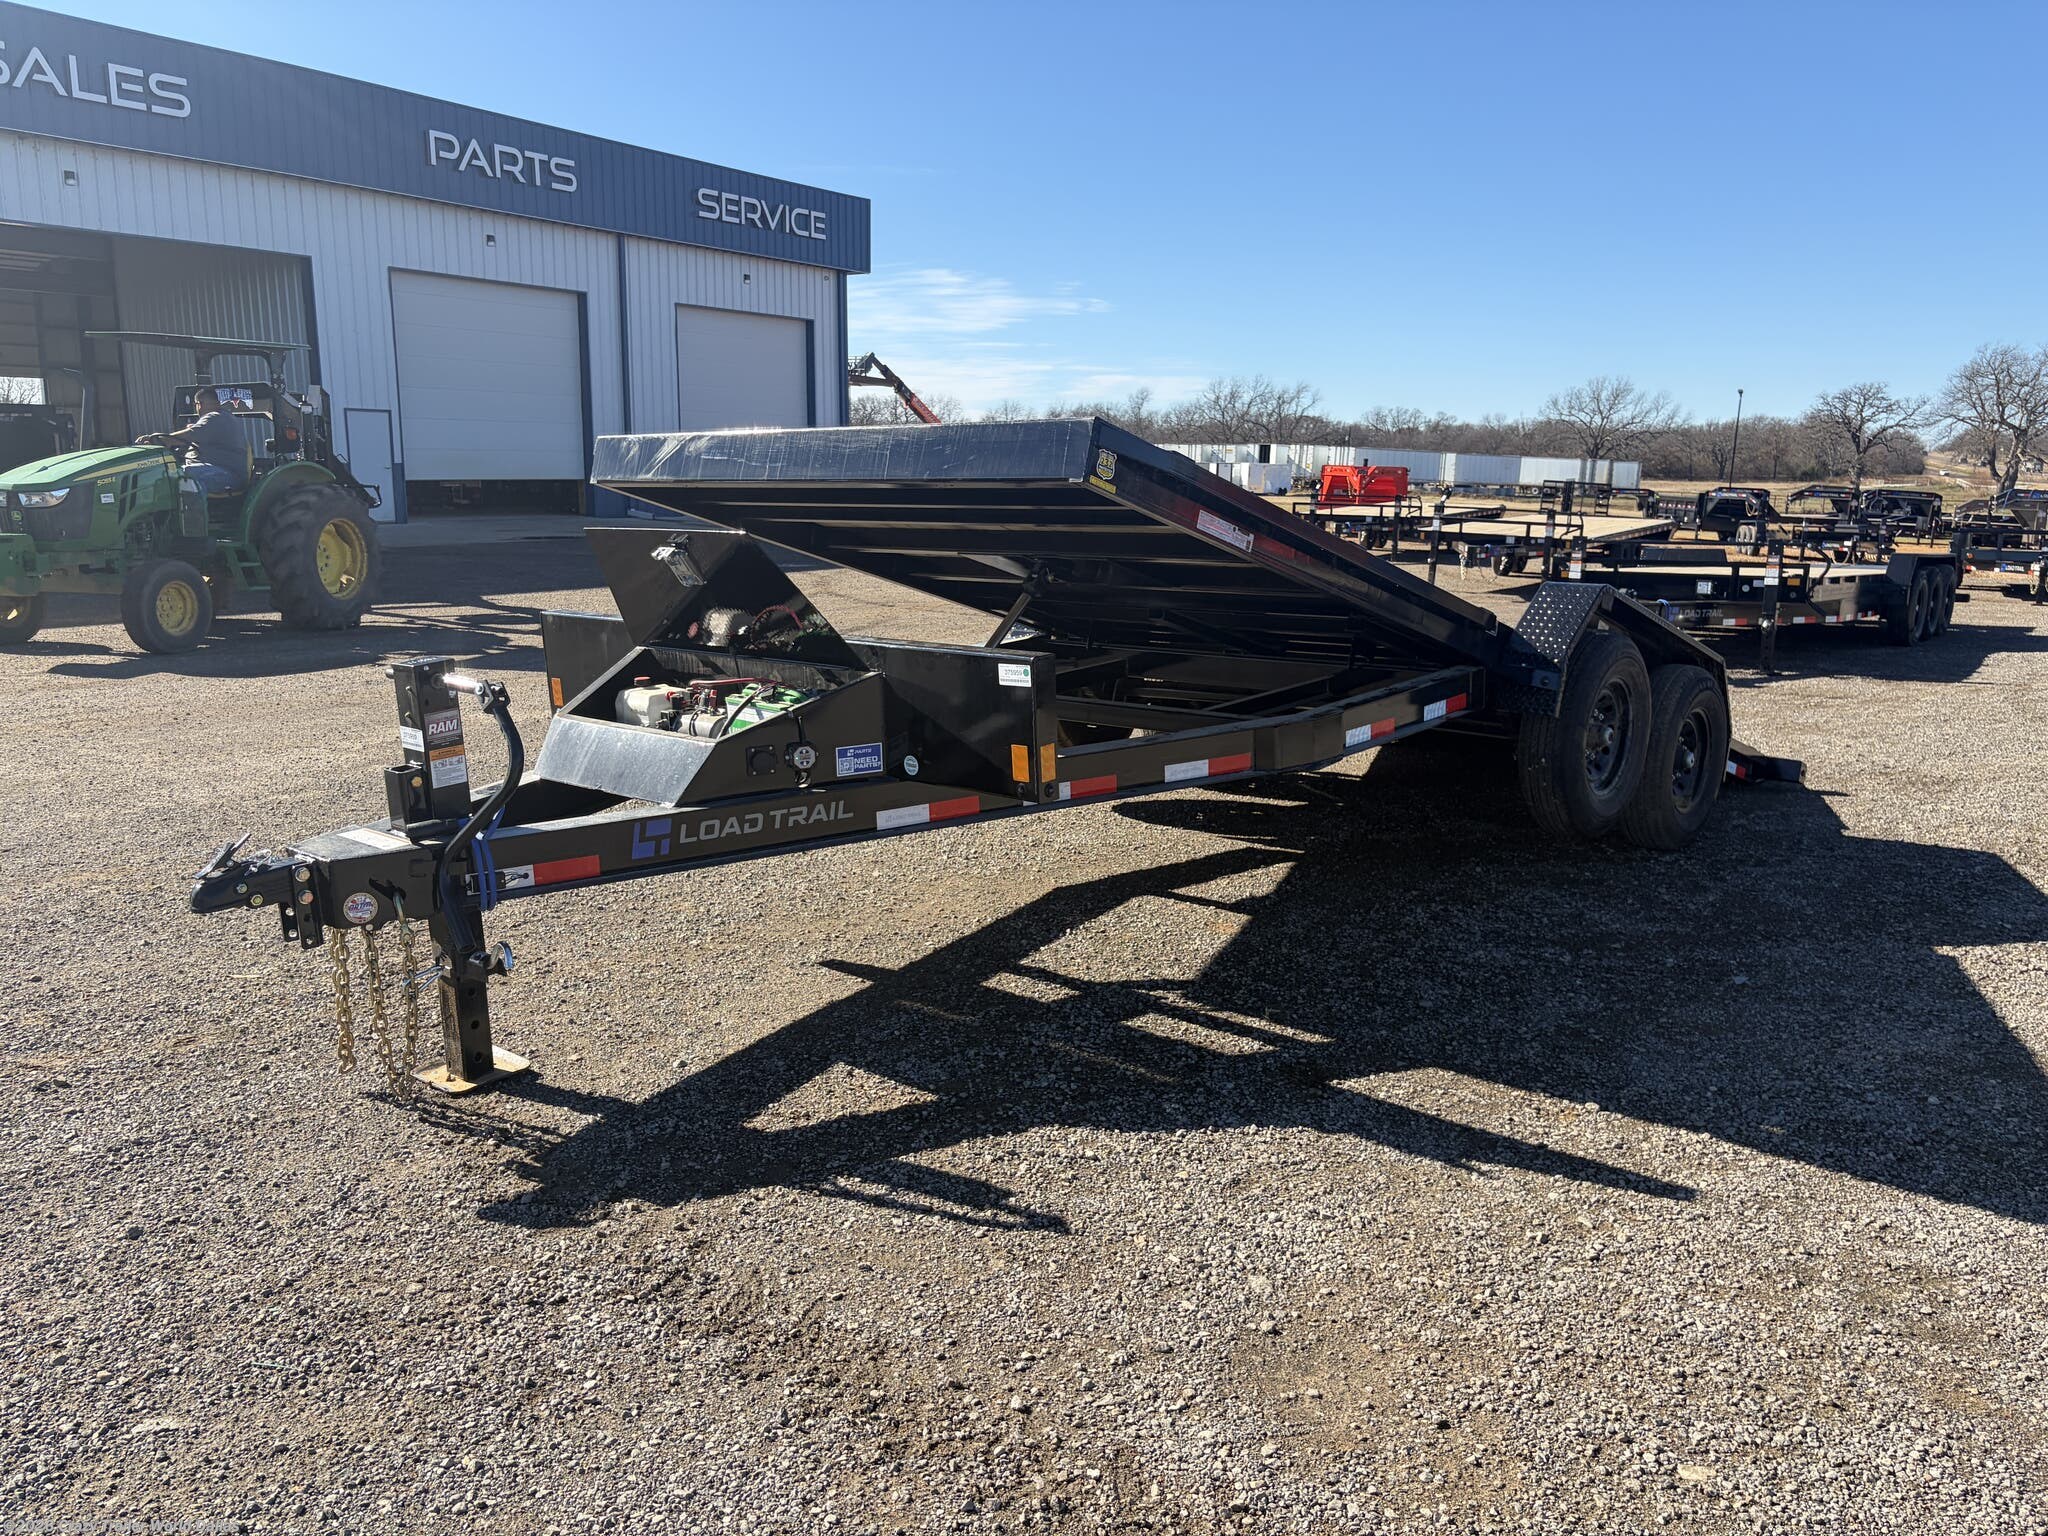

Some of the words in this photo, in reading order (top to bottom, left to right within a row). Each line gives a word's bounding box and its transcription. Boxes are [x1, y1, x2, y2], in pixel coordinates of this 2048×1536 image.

[0, 40, 191, 118] ALES
[428, 129, 578, 193] PARTS
[697, 187, 827, 240] SERVICE
[1680, 608, 1701, 618] LOAD
[1702, 608, 1724, 618] TRAIL
[428, 719, 458, 736] RAM
[854, 755, 878, 764] NEED
[854, 761, 881, 769] PARTS?
[679, 812, 764, 844] LOAD
[769, 799, 854, 830] TRAIL
